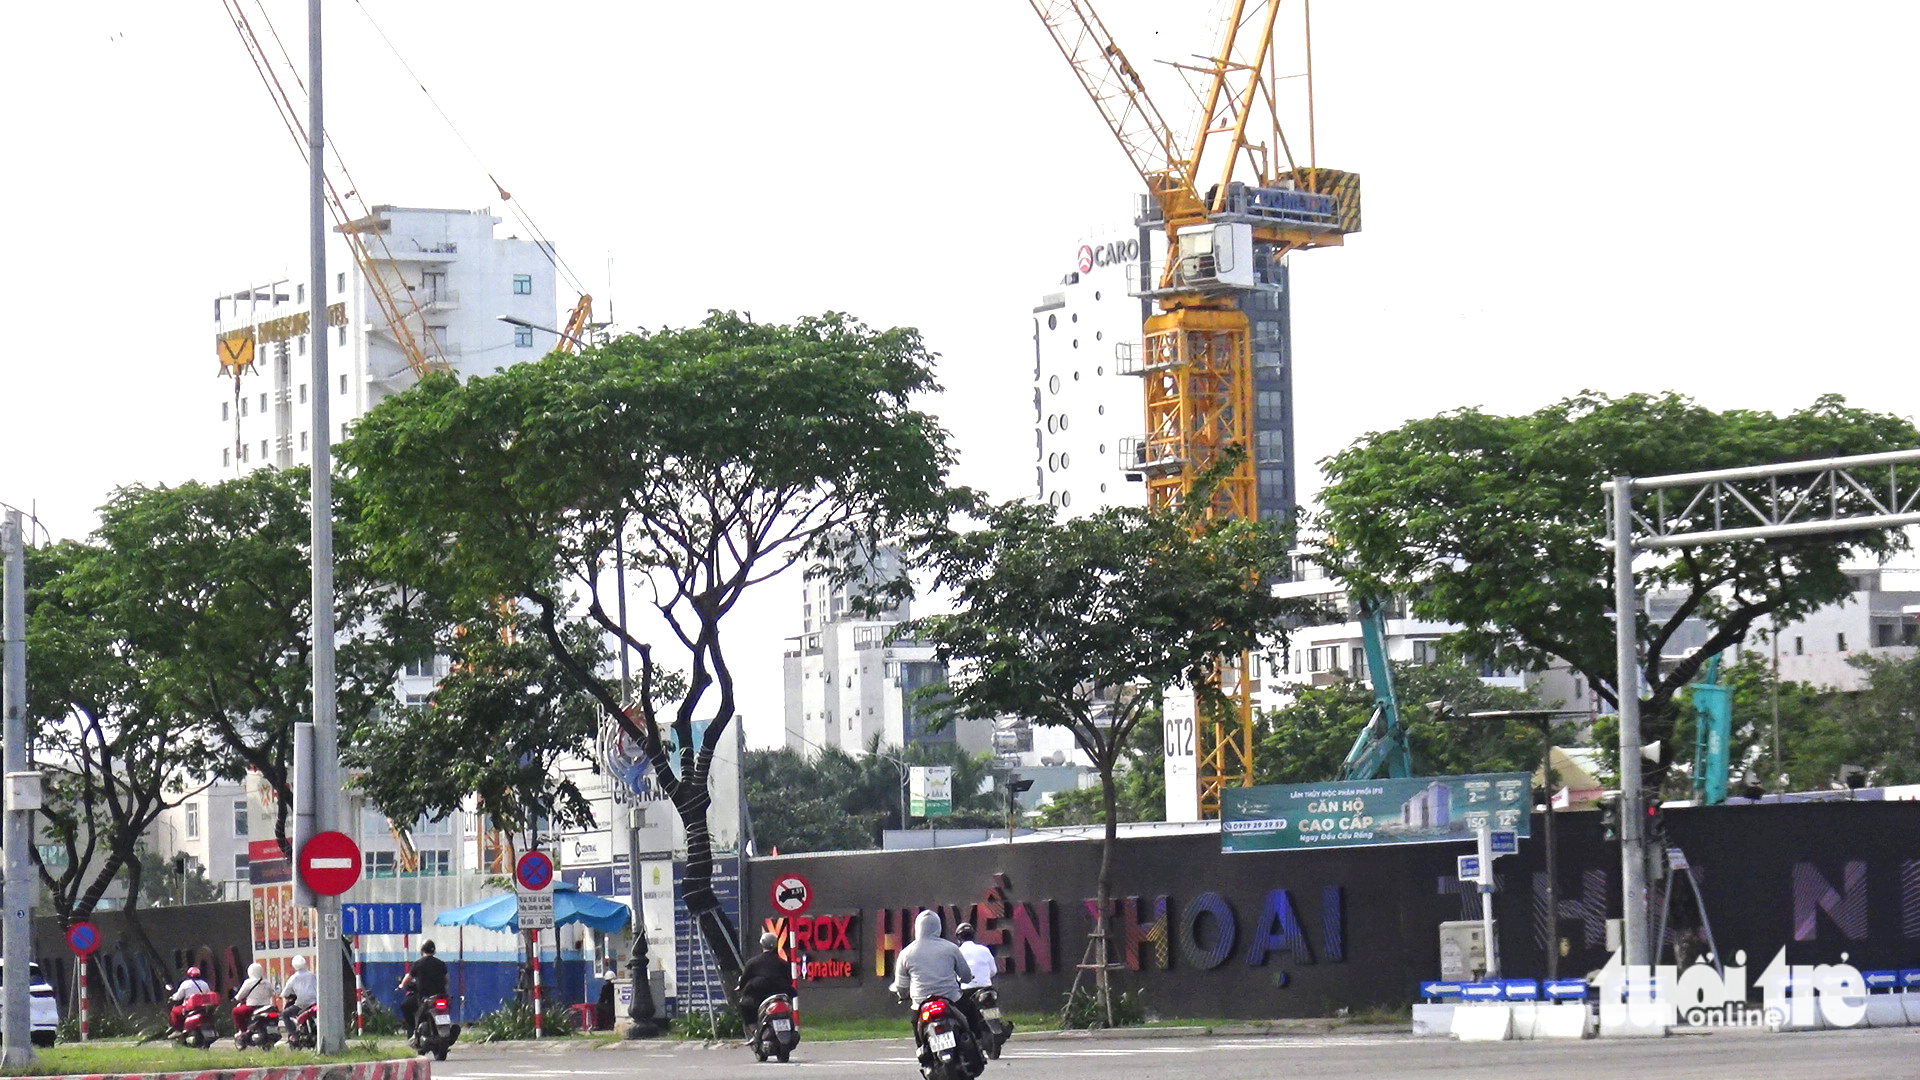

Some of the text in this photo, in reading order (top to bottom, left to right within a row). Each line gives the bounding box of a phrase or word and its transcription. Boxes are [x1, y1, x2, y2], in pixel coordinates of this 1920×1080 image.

[1093, 238, 1139, 268] CARO
[1166, 717, 1193, 757] CT2
[1308, 797, 1364, 814] CĂN HỘ
[1298, 812, 1374, 832] CAO CẤP
